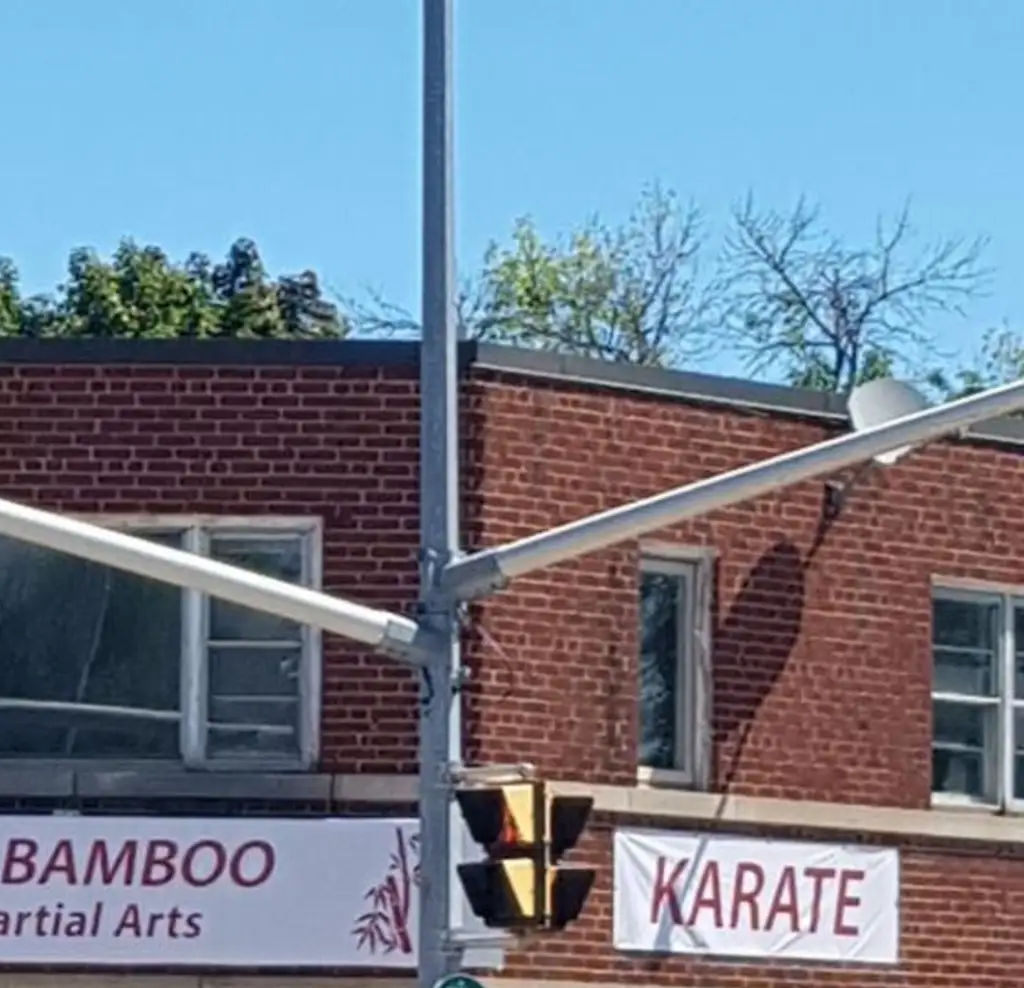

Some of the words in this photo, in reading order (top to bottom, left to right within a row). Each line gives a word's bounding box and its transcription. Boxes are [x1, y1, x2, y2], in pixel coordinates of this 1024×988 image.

[1, 838, 276, 888] BAMBOO
[114, 903, 203, 939] Arts
[650, 856, 866, 936] KARATE
